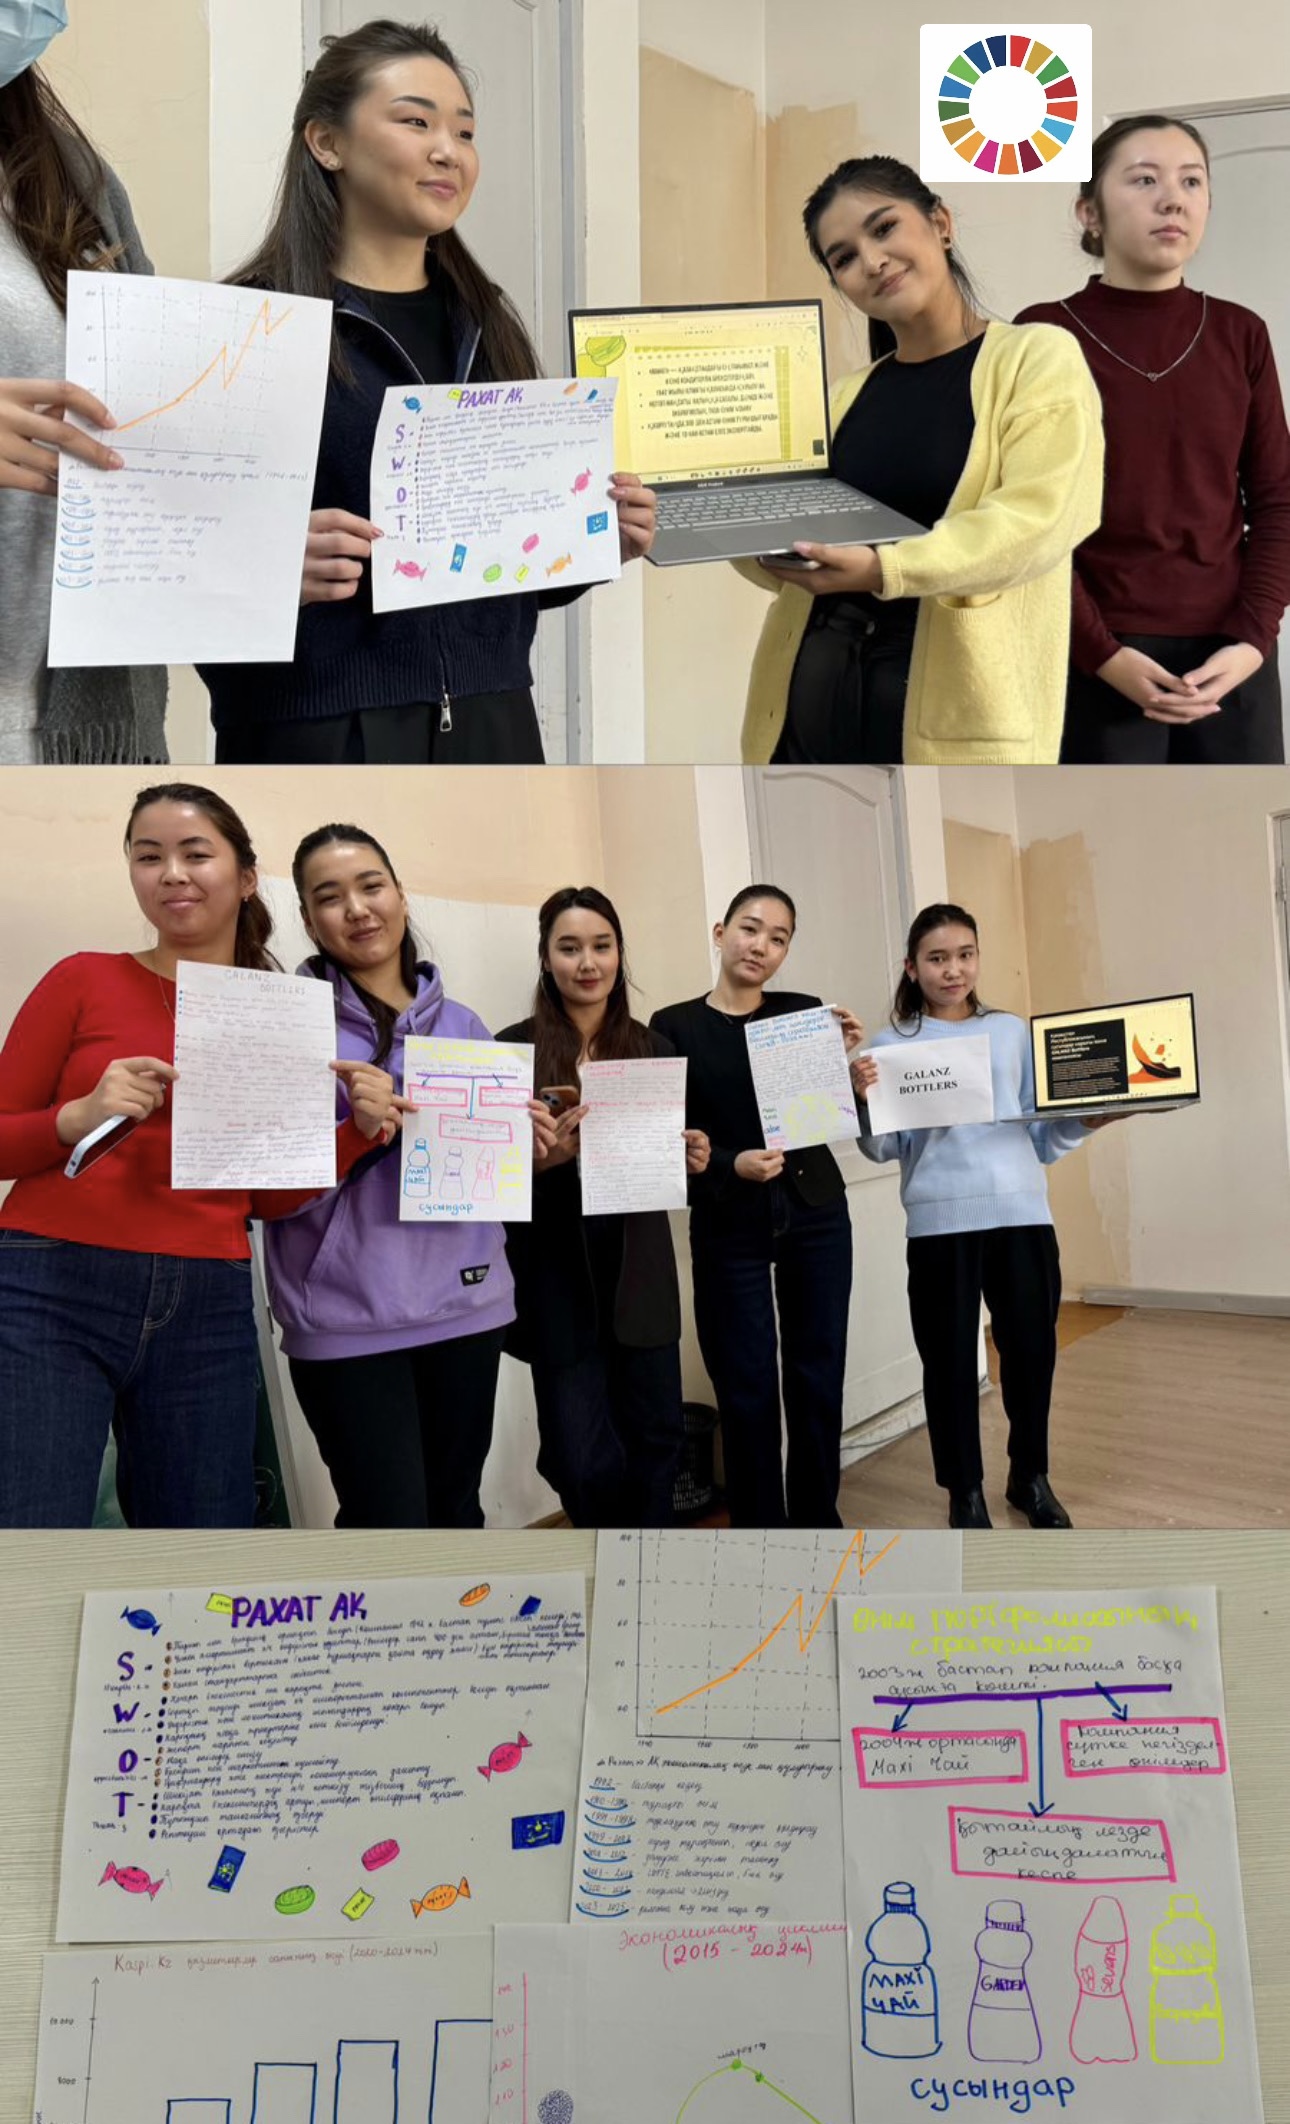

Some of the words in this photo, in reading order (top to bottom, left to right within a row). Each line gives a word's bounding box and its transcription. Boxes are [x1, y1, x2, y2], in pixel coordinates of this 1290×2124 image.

[457, 388, 503, 409] РАХАТ
[396, 424, 405, 444] S
[392, 456, 406, 470] W
[397, 487, 407, 503] O
[395, 514, 407, 532] T
[904, 1067, 951, 1080] GALANZ
[900, 1080, 958, 1095] BOTTLERS
[231, 1595, 322, 1629] РАХАТ
[329, 1591, 368, 1622] АҚ
[117, 1651, 134, 1682] S
[936, 1659, 1014, 1678] бастап
[1029, 1658, 1125, 1675] компания
[113, 1701, 140, 1724] W
[118, 1749, 138, 1773] O
[111, 1791, 134, 1818] T
[619, 1925, 757, 1951] Экономикалық
[872, 1991, 921, 2016] ЧАЙ
[910, 2075, 1077, 2114] сусындар
